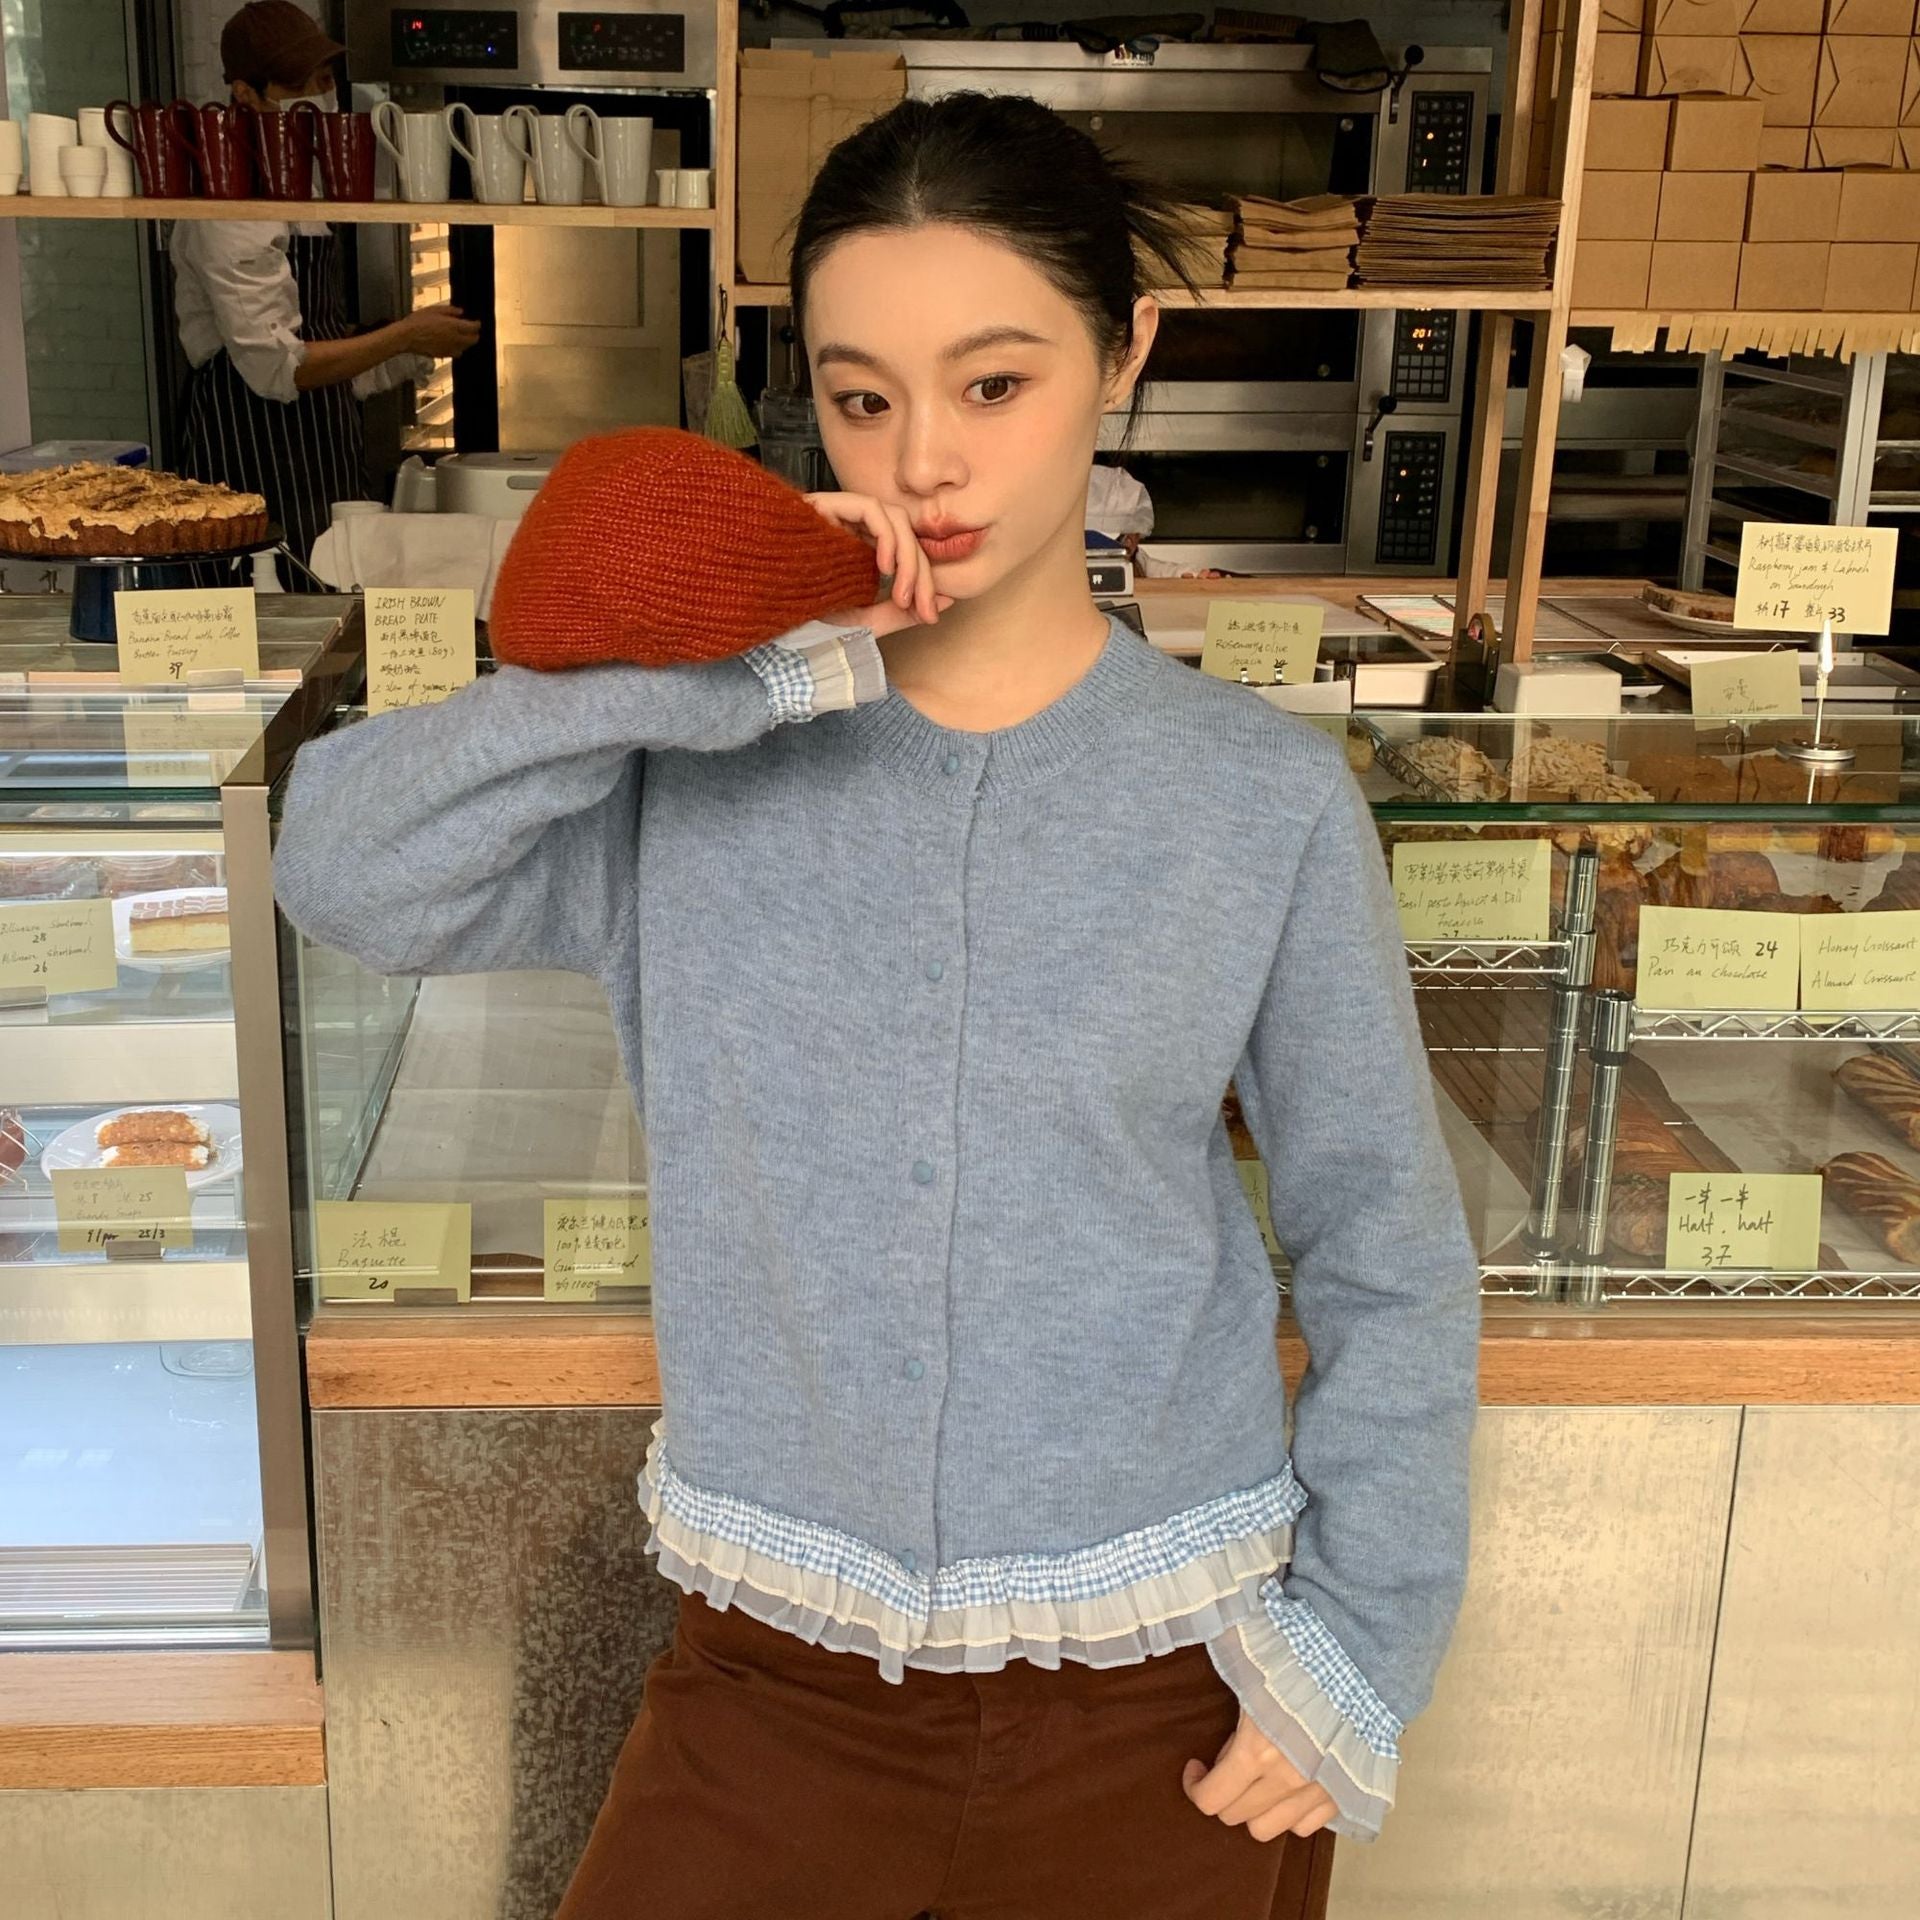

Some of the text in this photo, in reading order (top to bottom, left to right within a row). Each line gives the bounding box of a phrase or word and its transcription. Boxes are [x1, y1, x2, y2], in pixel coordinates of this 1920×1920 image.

[374, 614, 407, 627] BREAD
[1772, 600, 1790, 619] 17
[1828, 607, 1846, 623] 33
[1755, 941, 1779, 959] 24
[1818, 935, 1859, 959] Honey
[1701, 1244, 1732, 1266] 37
